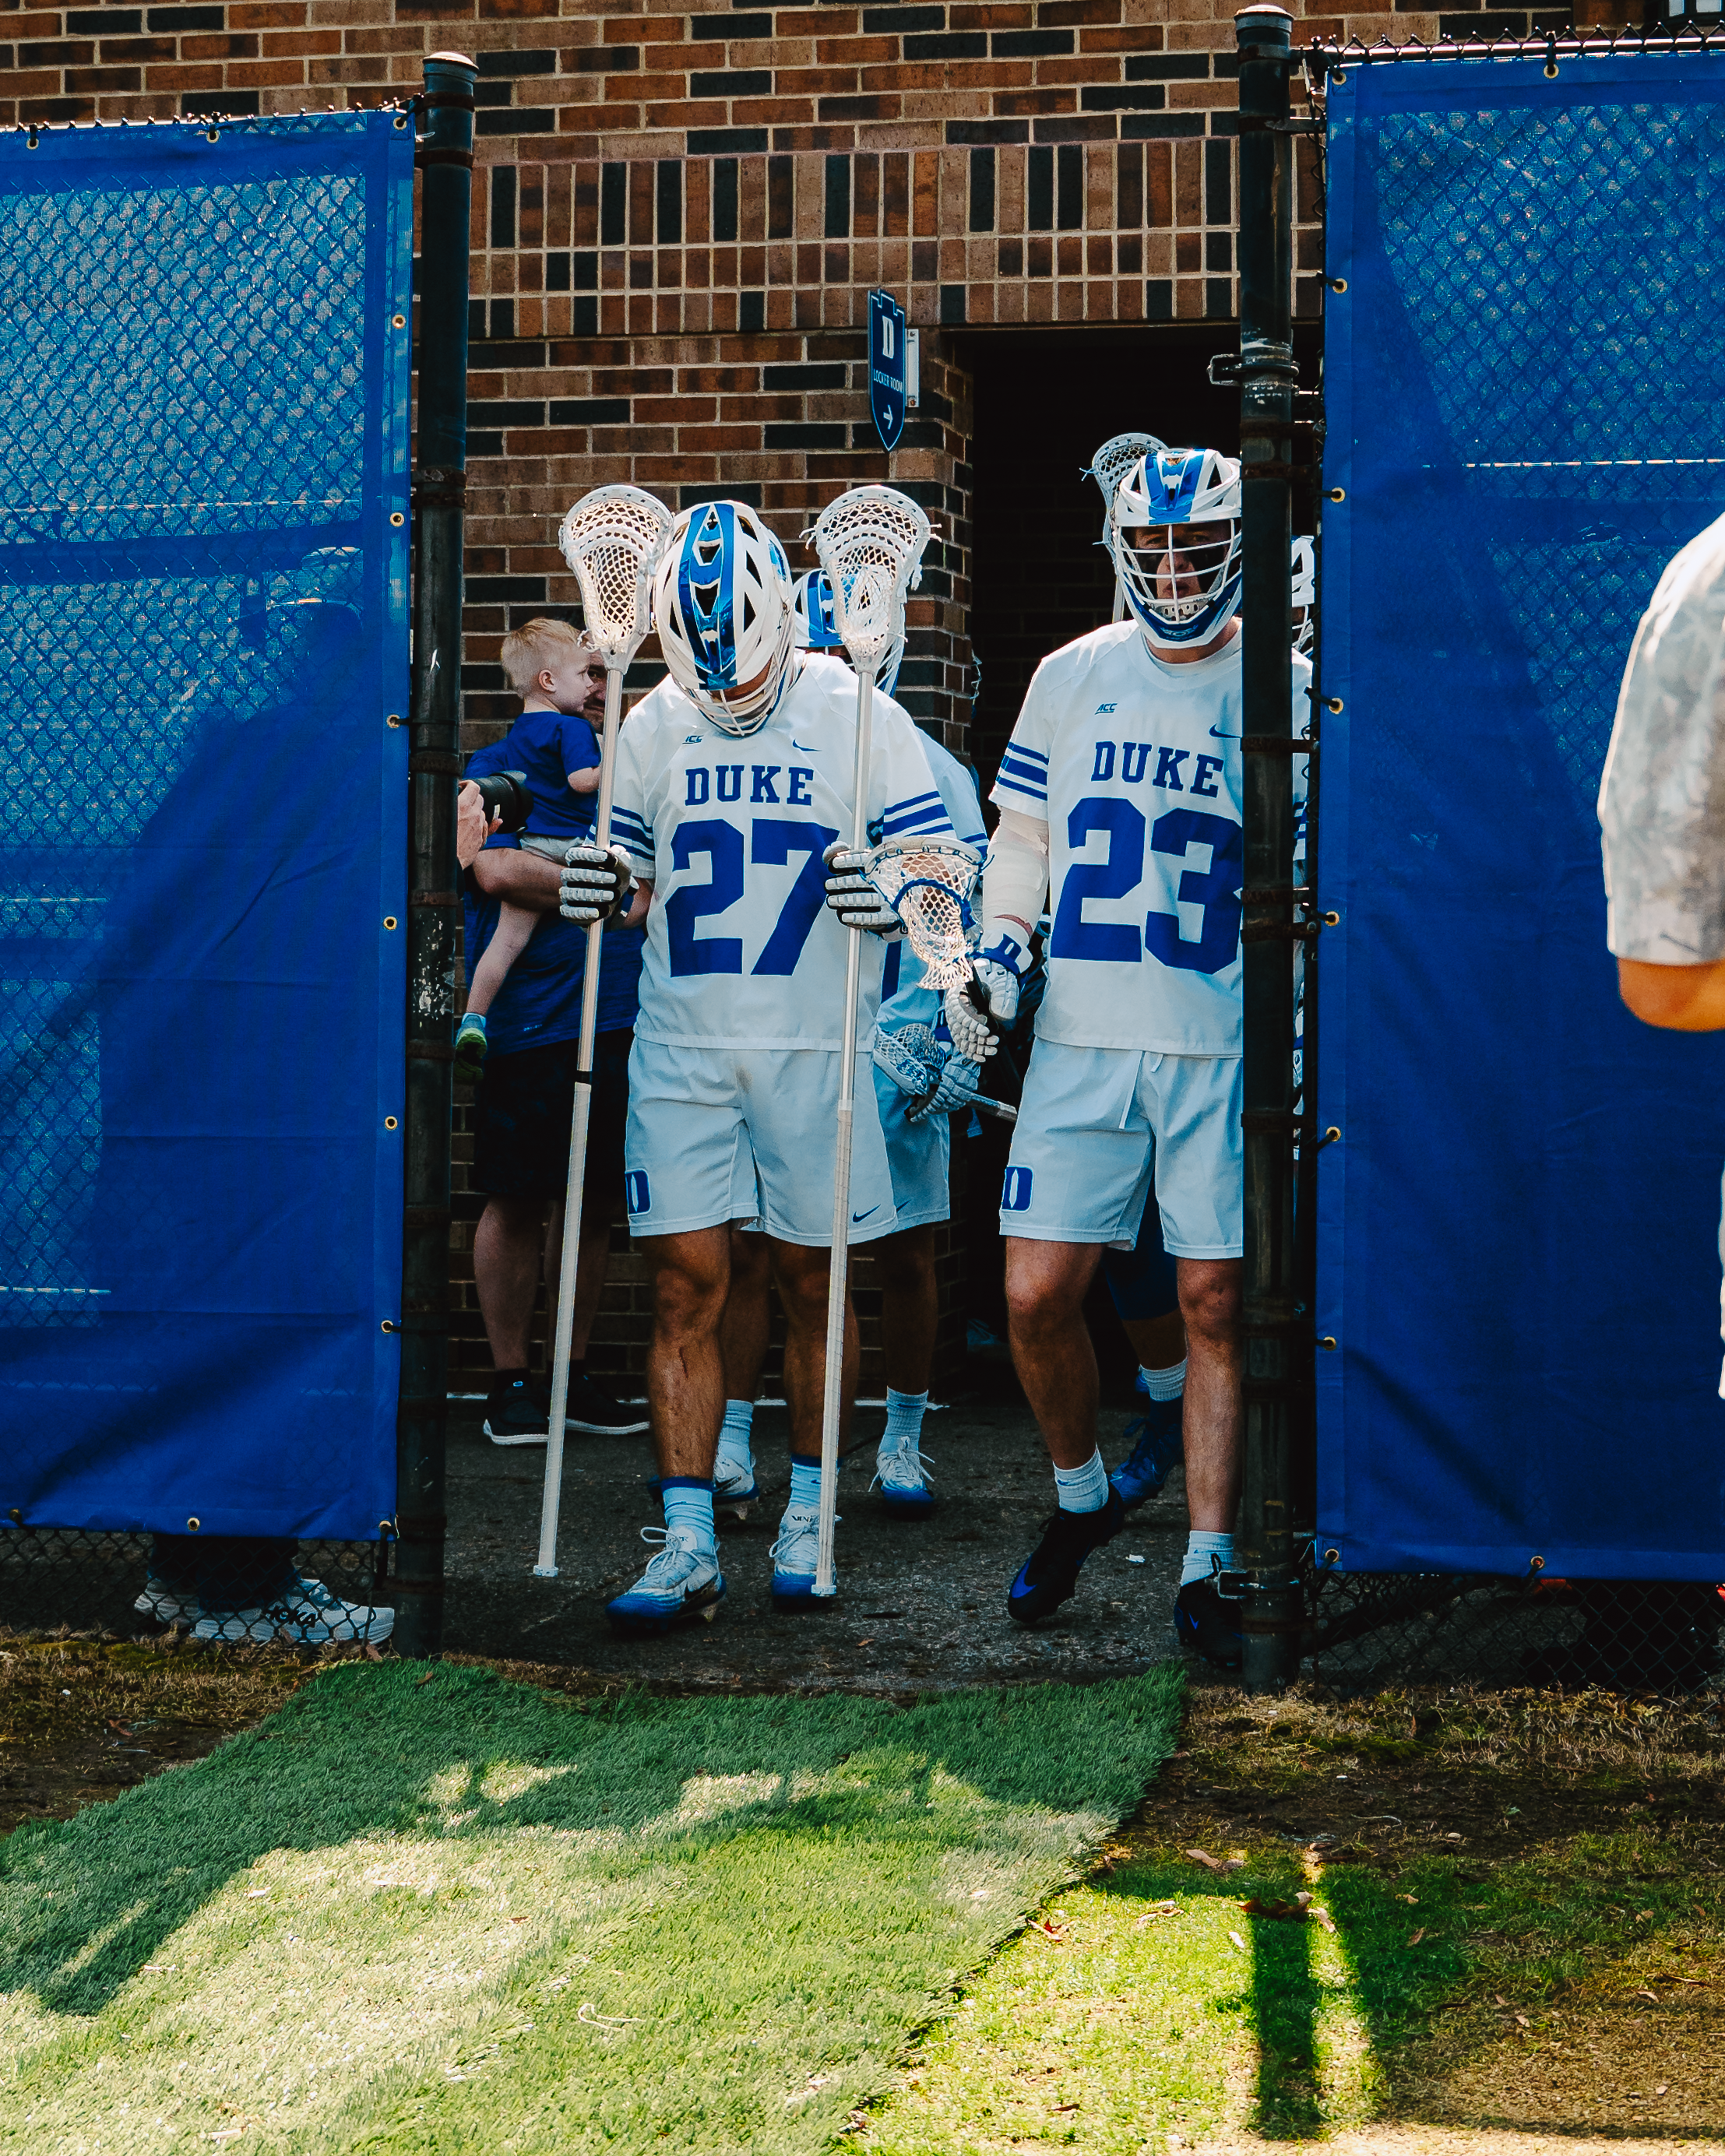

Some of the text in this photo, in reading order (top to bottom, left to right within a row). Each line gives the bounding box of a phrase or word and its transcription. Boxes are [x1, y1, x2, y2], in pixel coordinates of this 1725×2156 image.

[882, 315, 894, 359] D
[873, 368, 903, 393] LOCKER ROOM
[1095, 703, 1118, 714] ACC
[685, 765, 815, 807] DUKE
[1090, 741, 1224, 799] DUKE
[664, 818, 840, 978] 27
[1050, 797, 1243, 975] 23
